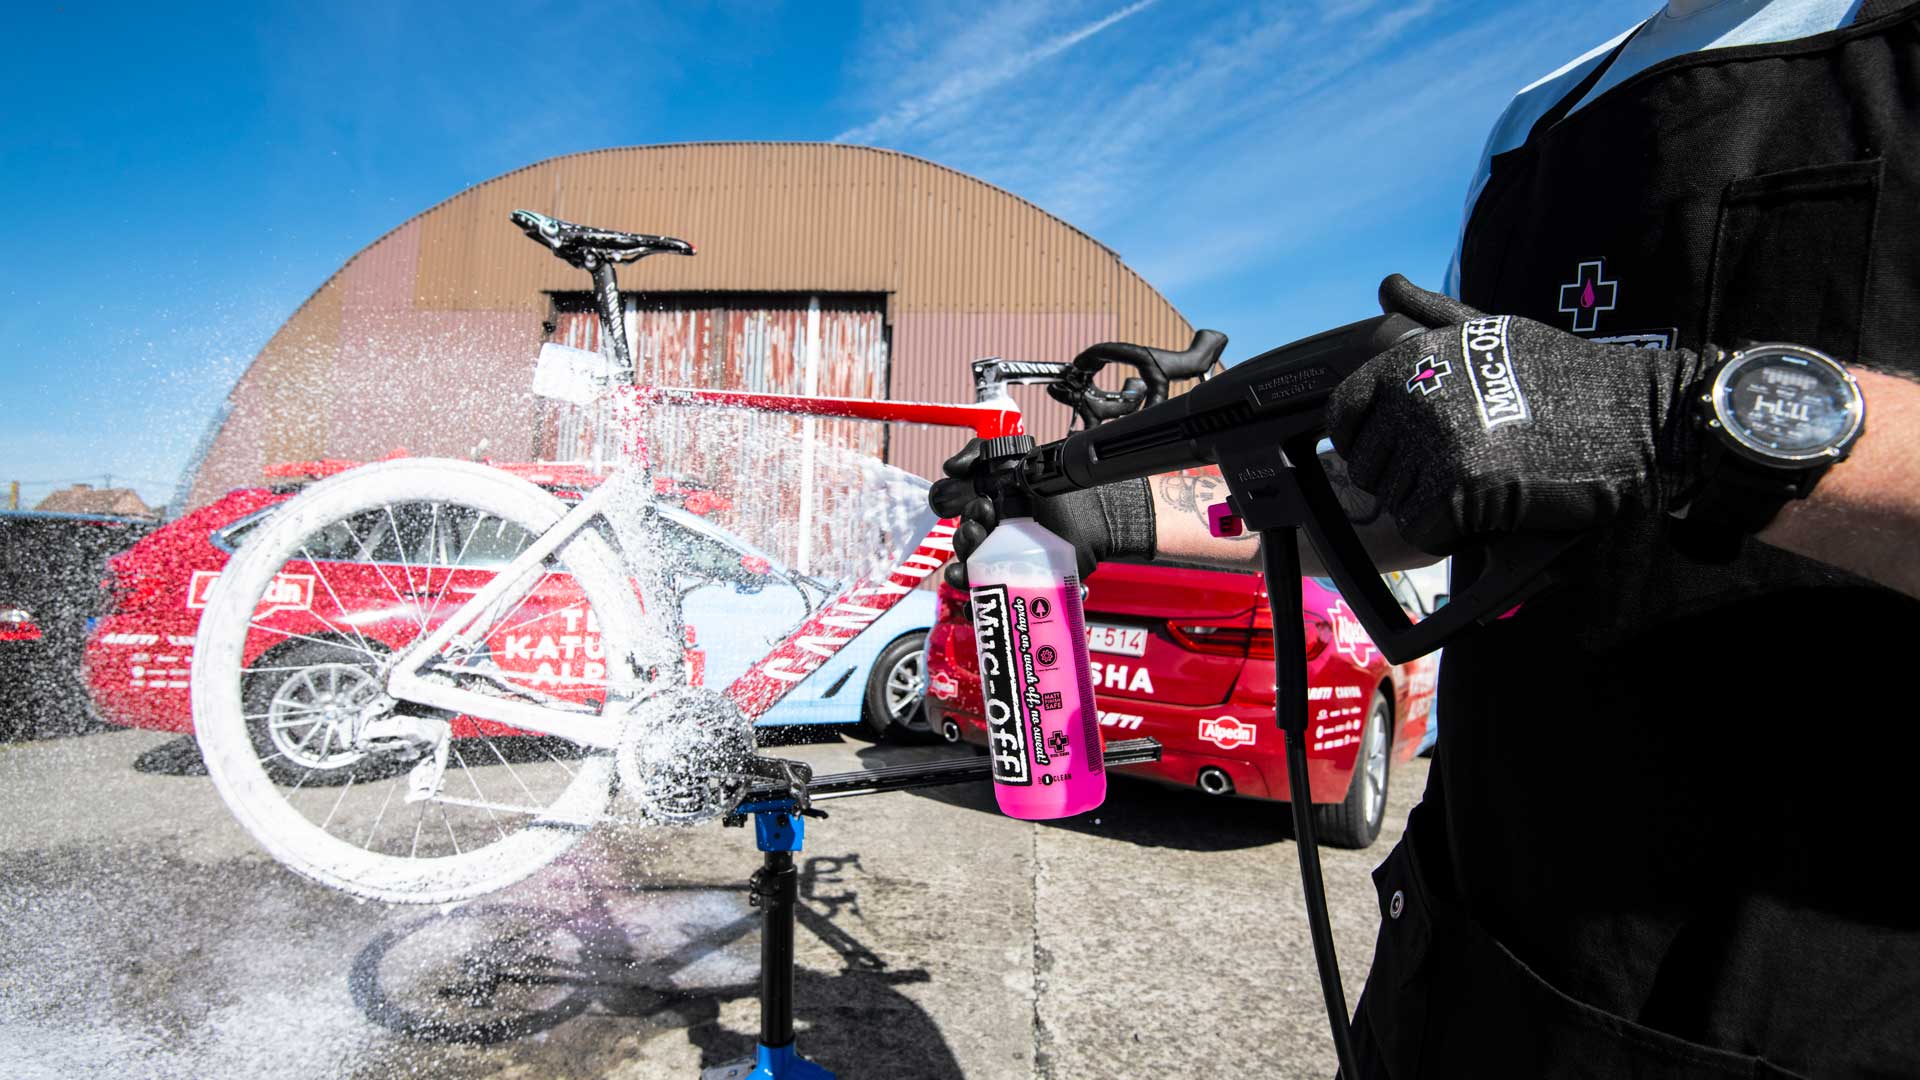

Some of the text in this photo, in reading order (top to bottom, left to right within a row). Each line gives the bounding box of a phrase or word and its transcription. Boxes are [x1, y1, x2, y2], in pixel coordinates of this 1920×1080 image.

[605, 281, 623, 339] CANYON
[998, 362, 1061, 374] CANYON
[1013, 597, 1028, 633] spray
[505, 634, 607, 660] KATU
[1023, 653, 1039, 685] wash
[1090, 661, 1154, 694] SHA
[974, 597, 1022, 774] Muc-Off
[1030, 709, 1041, 725] no
[1045, 702, 1062, 710] SAFE
[1203, 723, 1250, 742] Alpecin
[1053, 773, 1072, 783] CLEAN
